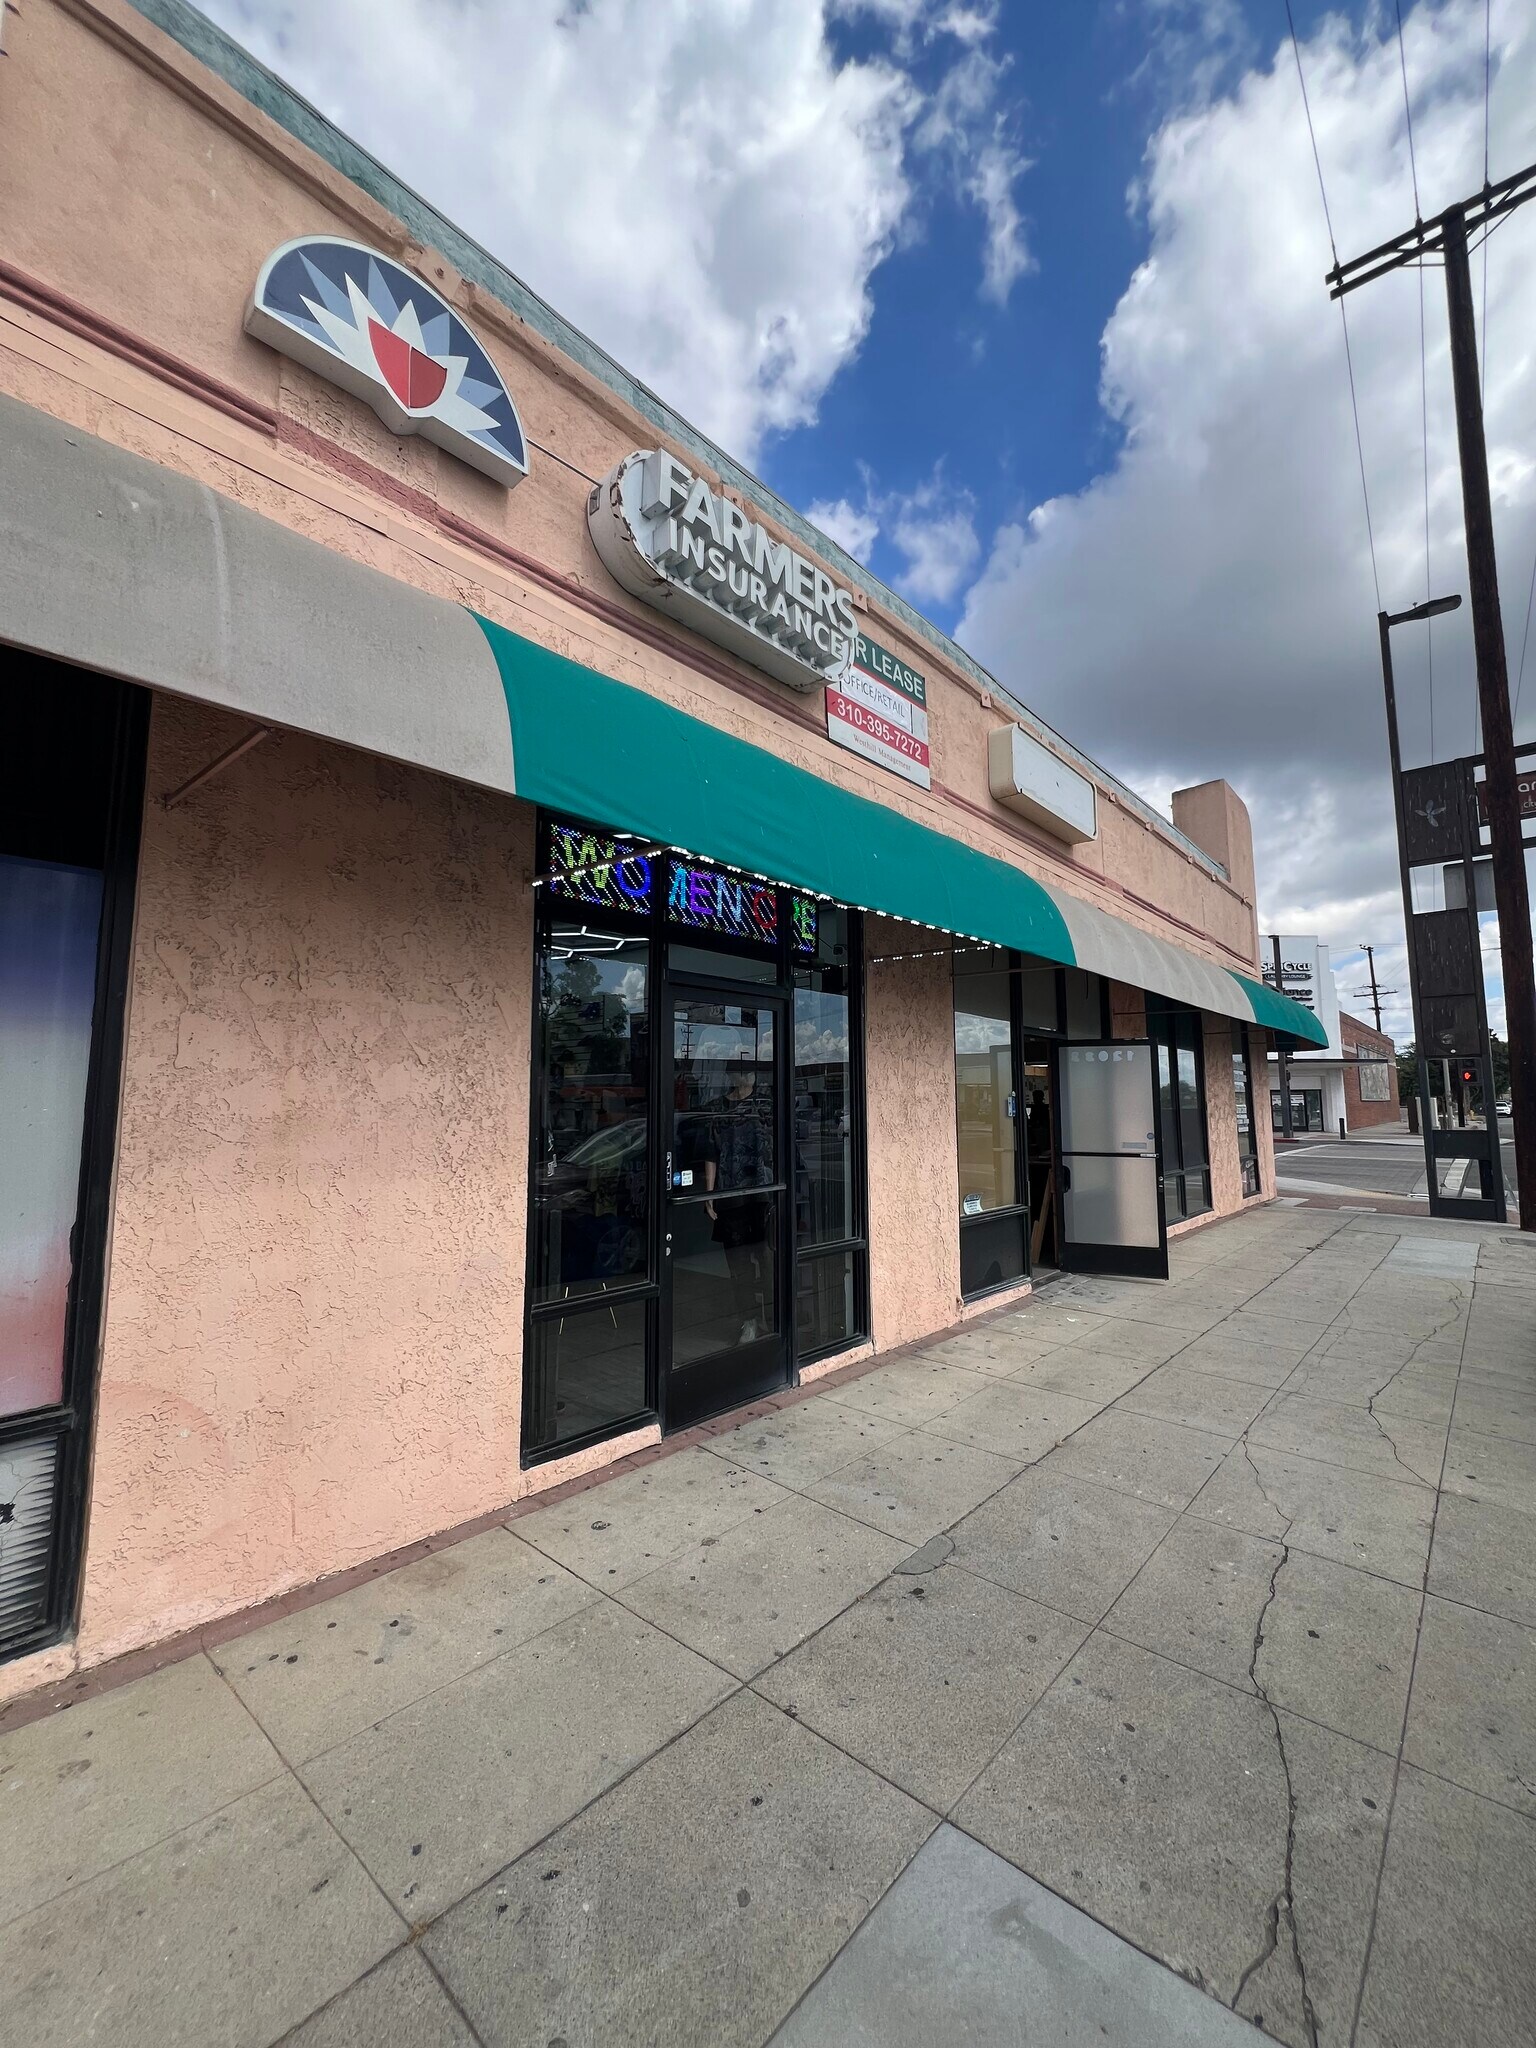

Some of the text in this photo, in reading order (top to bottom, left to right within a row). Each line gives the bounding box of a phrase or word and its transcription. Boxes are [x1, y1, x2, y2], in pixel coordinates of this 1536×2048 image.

[658, 448, 859, 638] FARMERS
[668, 517, 844, 661] INSURANCE
[872, 647, 924, 700] LEASE
[837, 698, 922, 761] 310-395-7272
[853, 734, 911, 771] Westhill Management
